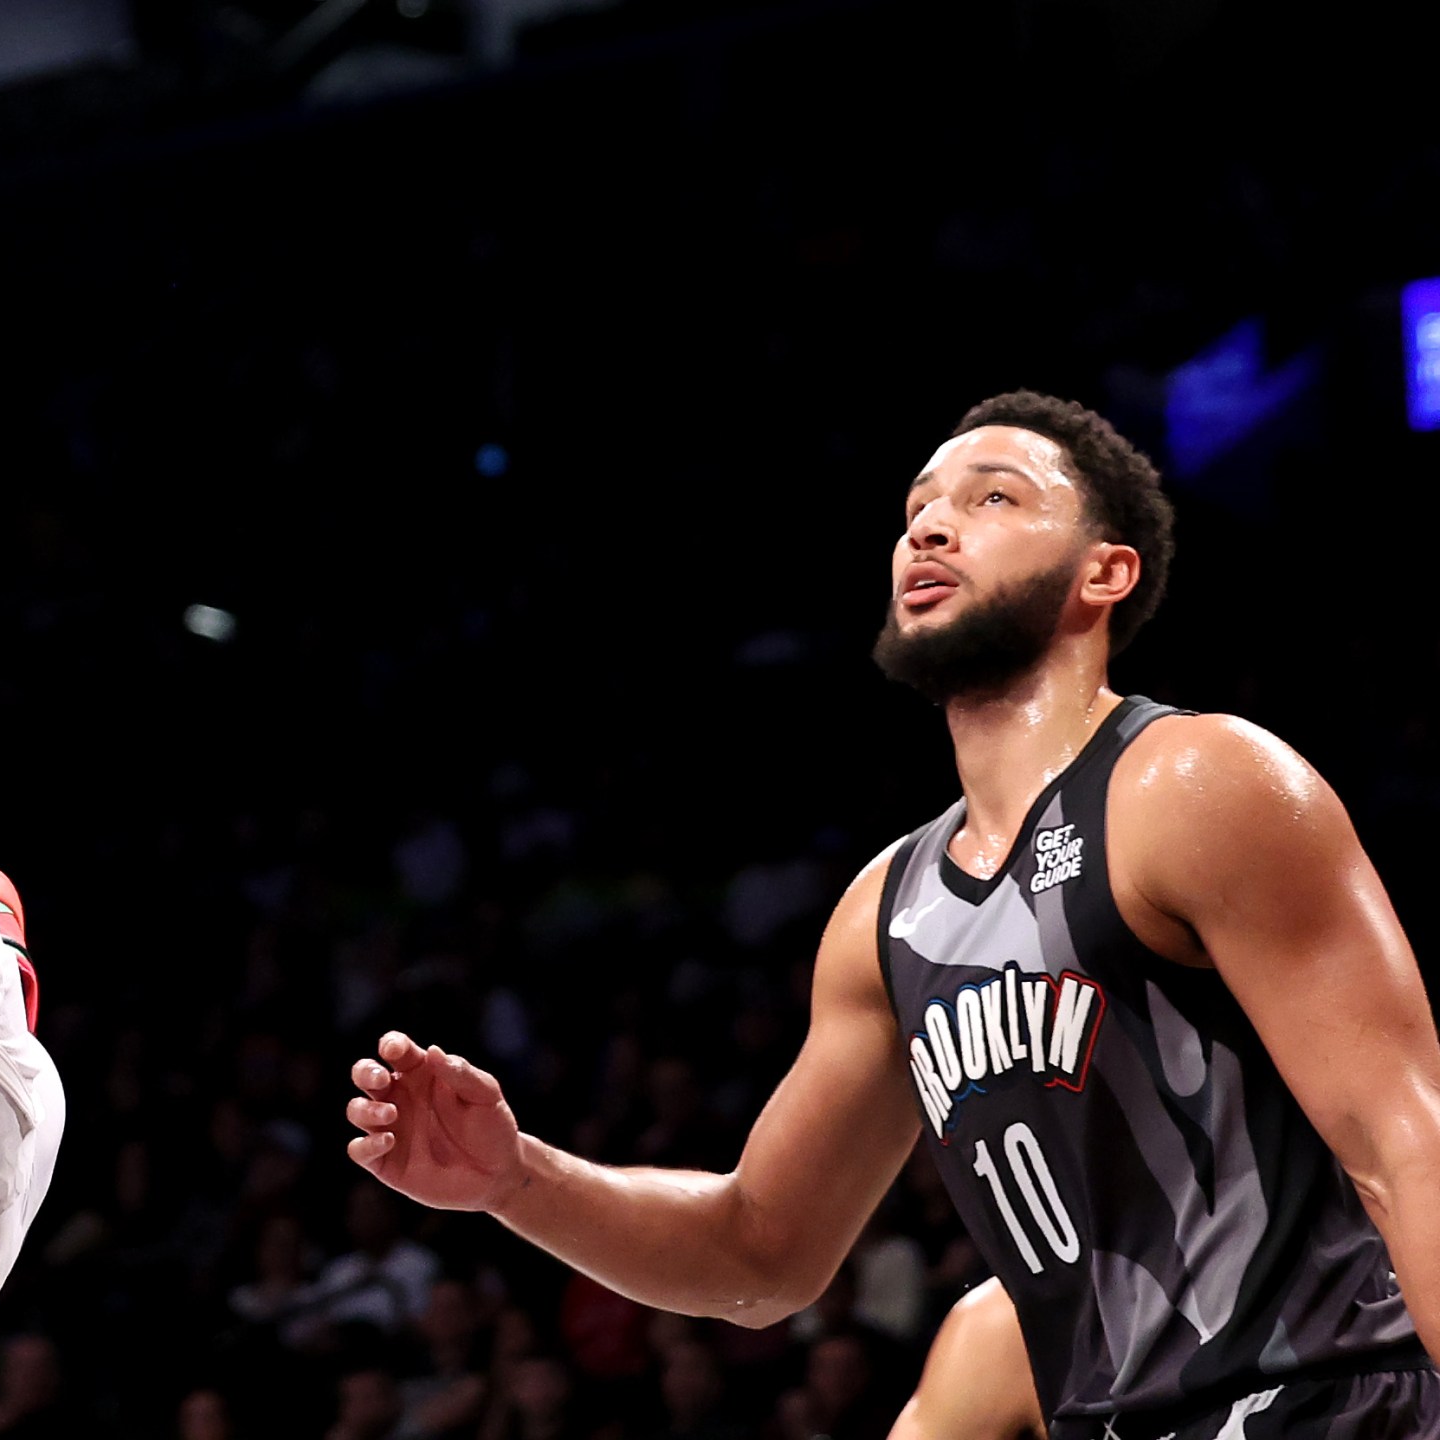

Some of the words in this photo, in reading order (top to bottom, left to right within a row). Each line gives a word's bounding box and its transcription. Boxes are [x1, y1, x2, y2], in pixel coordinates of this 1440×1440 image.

[1035, 837, 1084, 872] YOUR
[1036, 823, 1076, 852] GET
[1030, 856, 1083, 893] GUIDE
[972, 1122, 1081, 1276] 10
